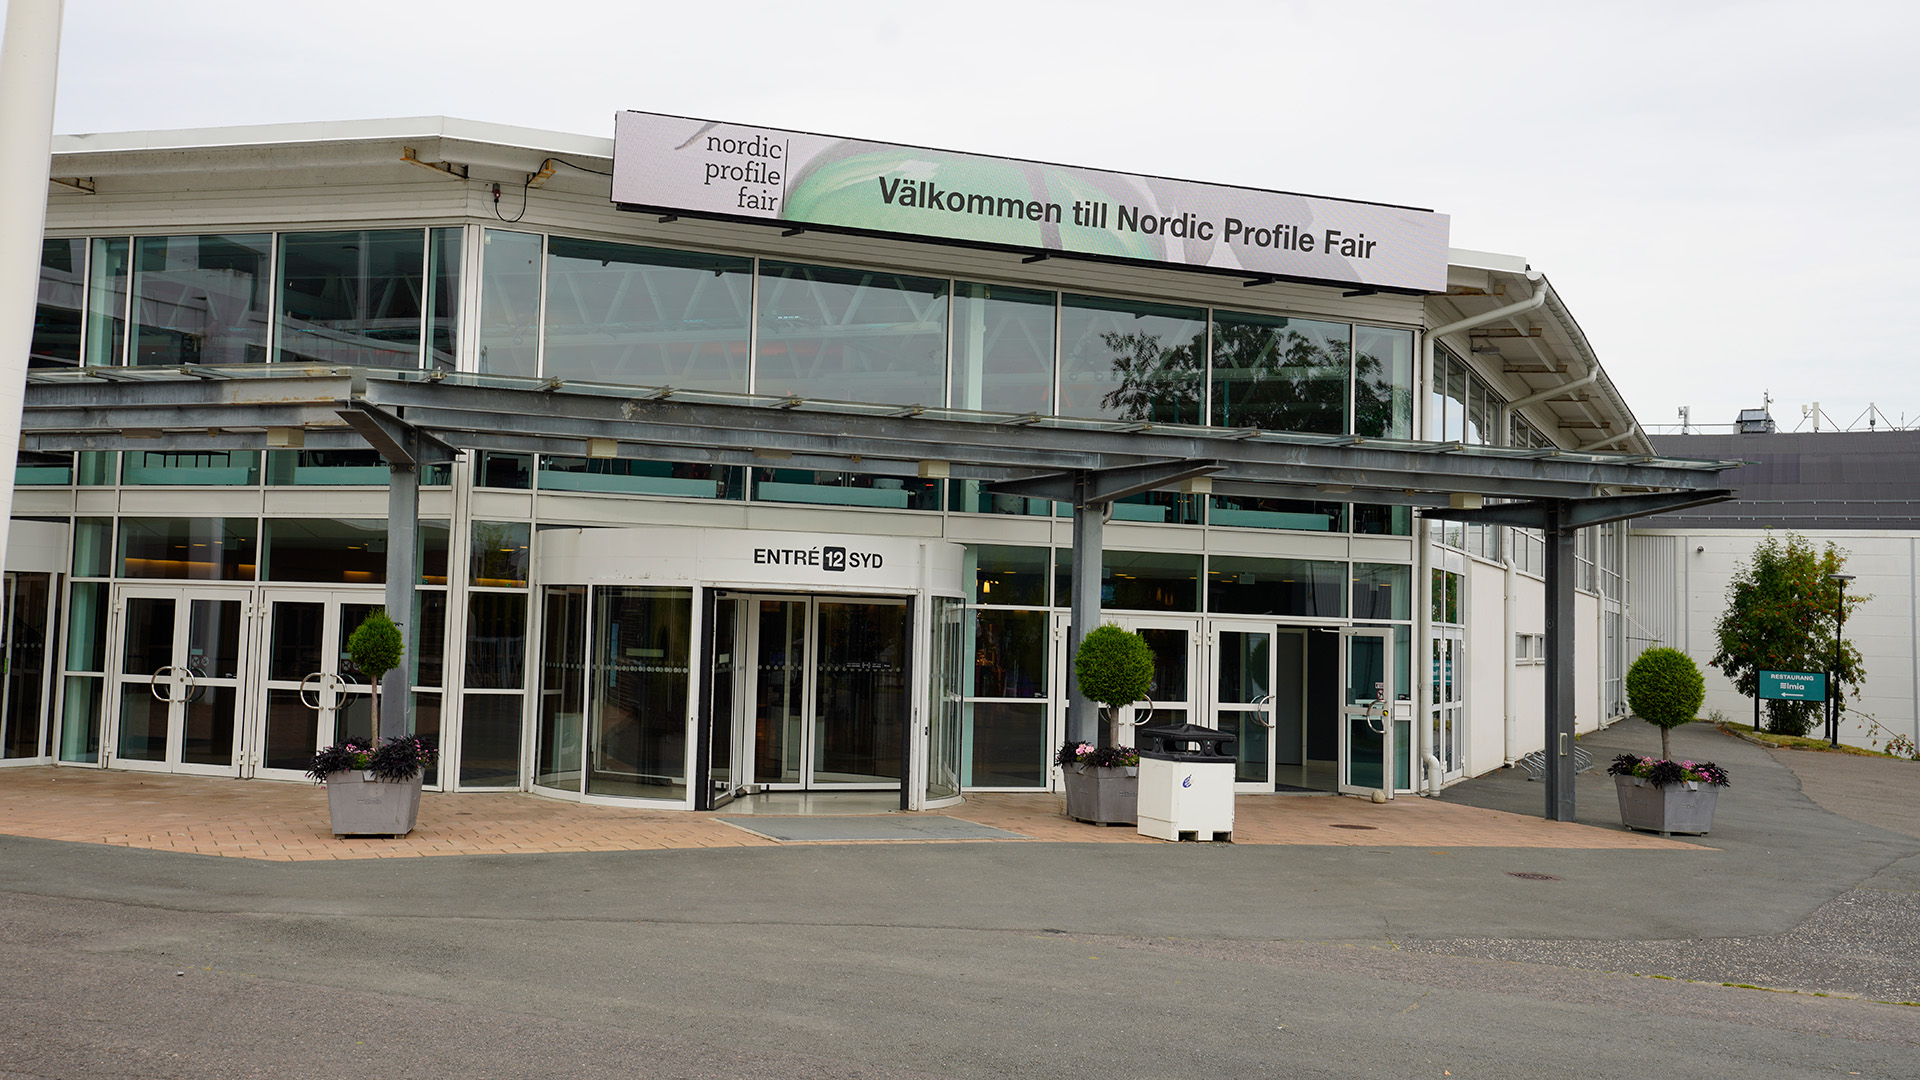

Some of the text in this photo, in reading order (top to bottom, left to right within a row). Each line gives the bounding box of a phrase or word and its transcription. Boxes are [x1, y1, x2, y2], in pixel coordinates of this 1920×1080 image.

[706, 135, 782, 160] nordic
[704, 158, 782, 186] profile
[737, 186, 779, 212] fair
[878, 176, 1377, 260] Välkommen till Nordic Profile Fair
[754, 546, 883, 569] ENTRÉ 12 SYD
[1780, 682, 1805, 690] Elmia
